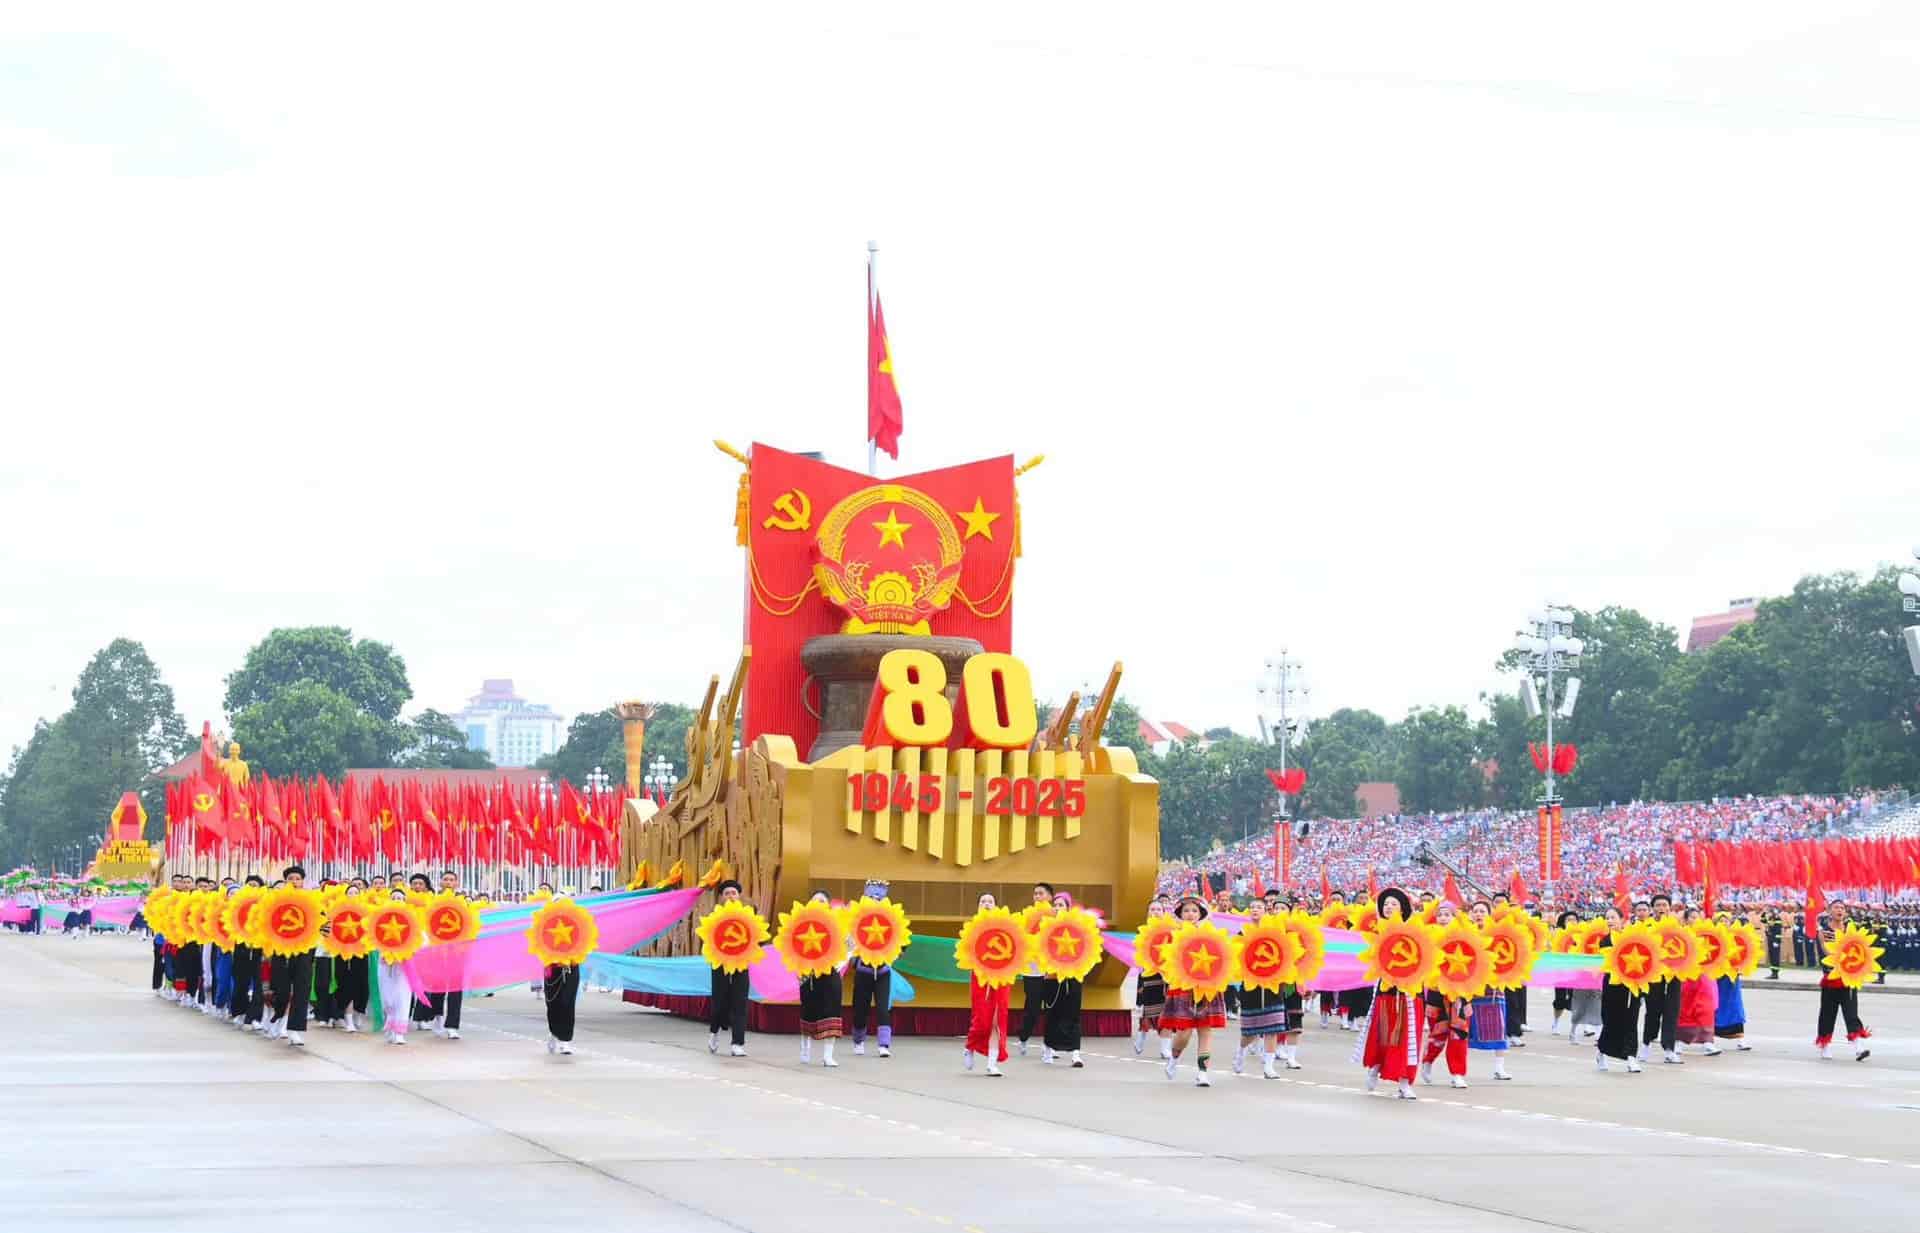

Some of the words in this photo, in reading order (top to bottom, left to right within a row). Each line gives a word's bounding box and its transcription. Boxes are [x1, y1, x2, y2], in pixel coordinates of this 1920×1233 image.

[878, 648, 1038, 747] 80
[848, 772, 942, 815] 1945
[958, 791, 973, 800] -
[986, 777, 1087, 818] 2025
